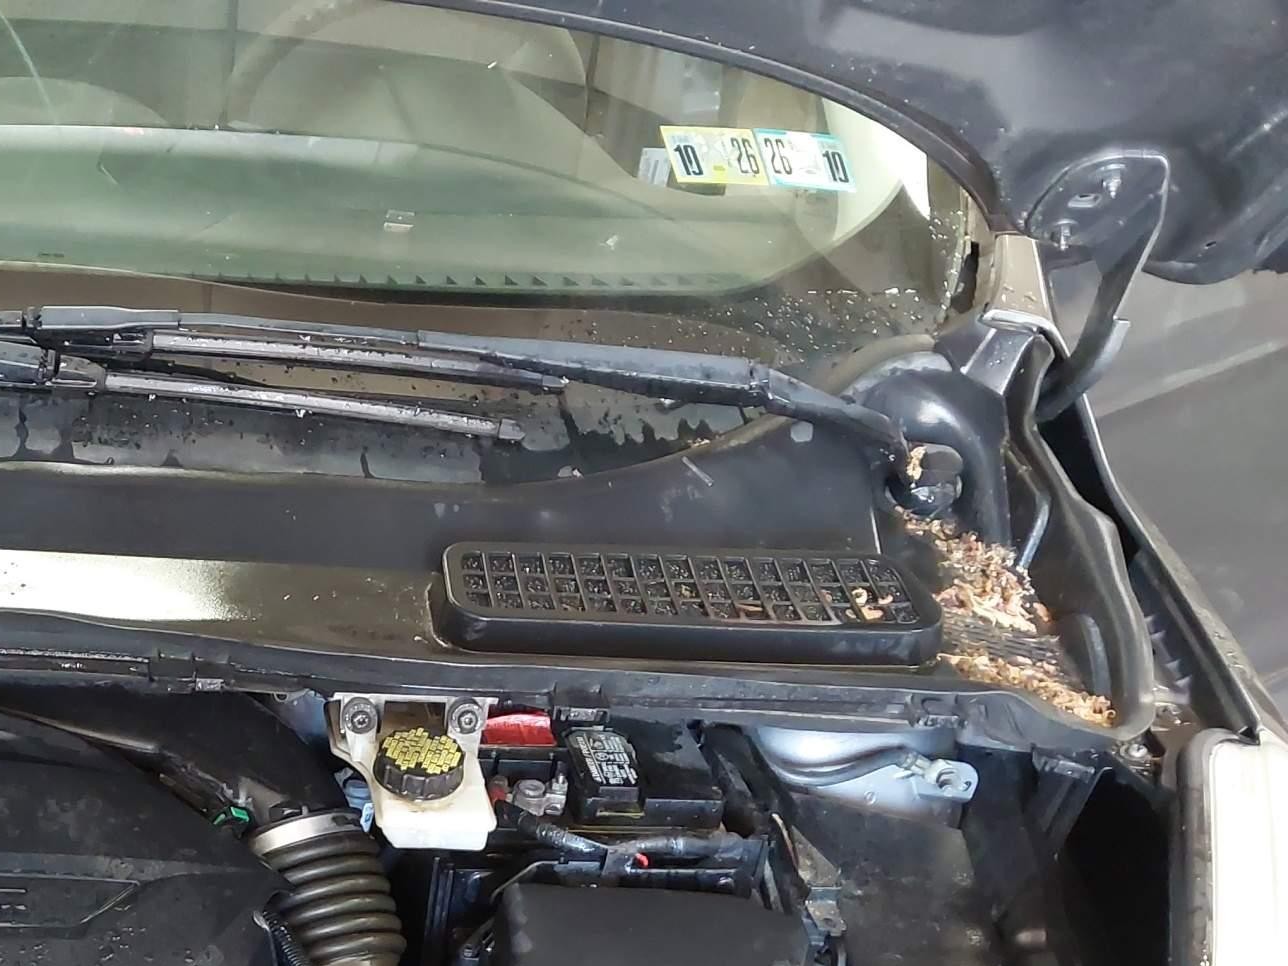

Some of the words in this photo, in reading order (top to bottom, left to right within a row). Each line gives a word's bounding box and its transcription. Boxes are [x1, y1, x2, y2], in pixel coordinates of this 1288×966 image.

[674, 144, 704, 176] 10
[730, 137, 760, 175] 26
[764, 137, 793, 175] 26
[822, 150, 850, 183] 10
